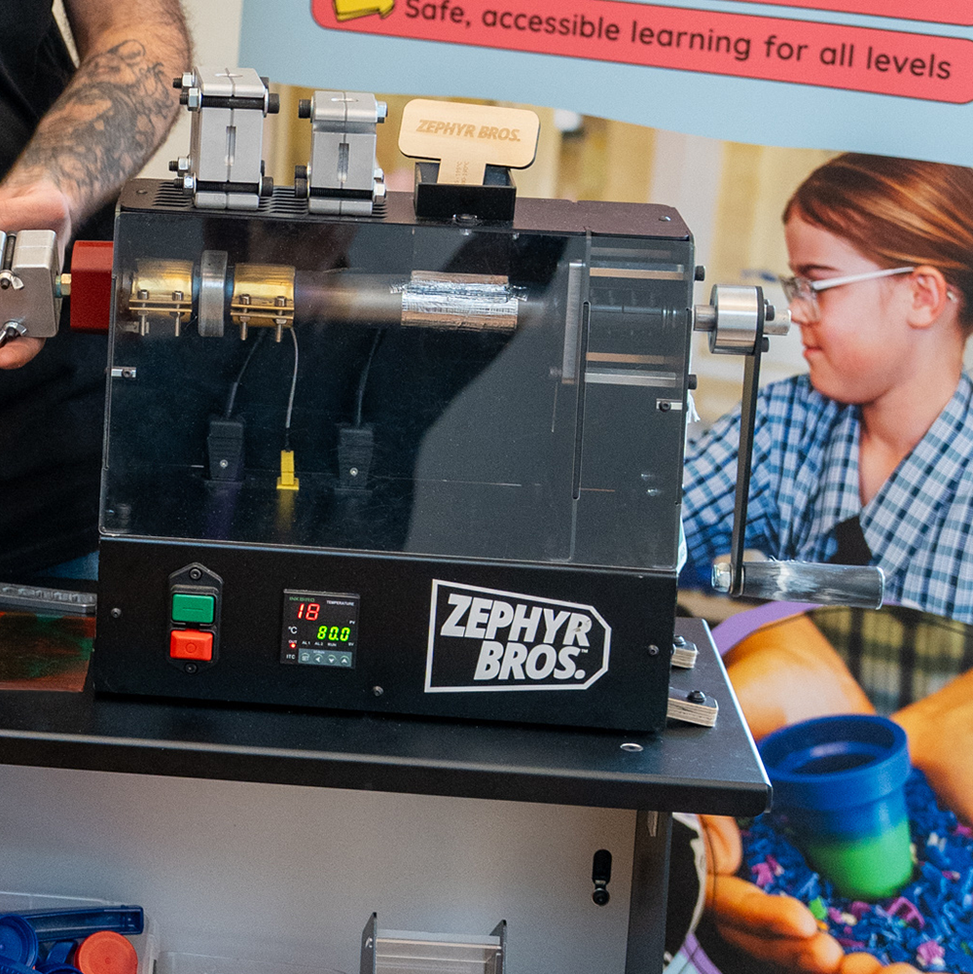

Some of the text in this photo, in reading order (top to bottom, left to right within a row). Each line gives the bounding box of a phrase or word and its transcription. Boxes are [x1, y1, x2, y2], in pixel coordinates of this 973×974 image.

[405, 0, 952, 80] Safe, accessible learning for all levels
[416, 119, 521, 142] ZEPHYR BROS.
[297, 603, 321, 621] 18
[439, 593, 593, 647] ZEPHYR
[317, 625, 351, 642] 80.0
[473, 640, 586, 681] BROS.
